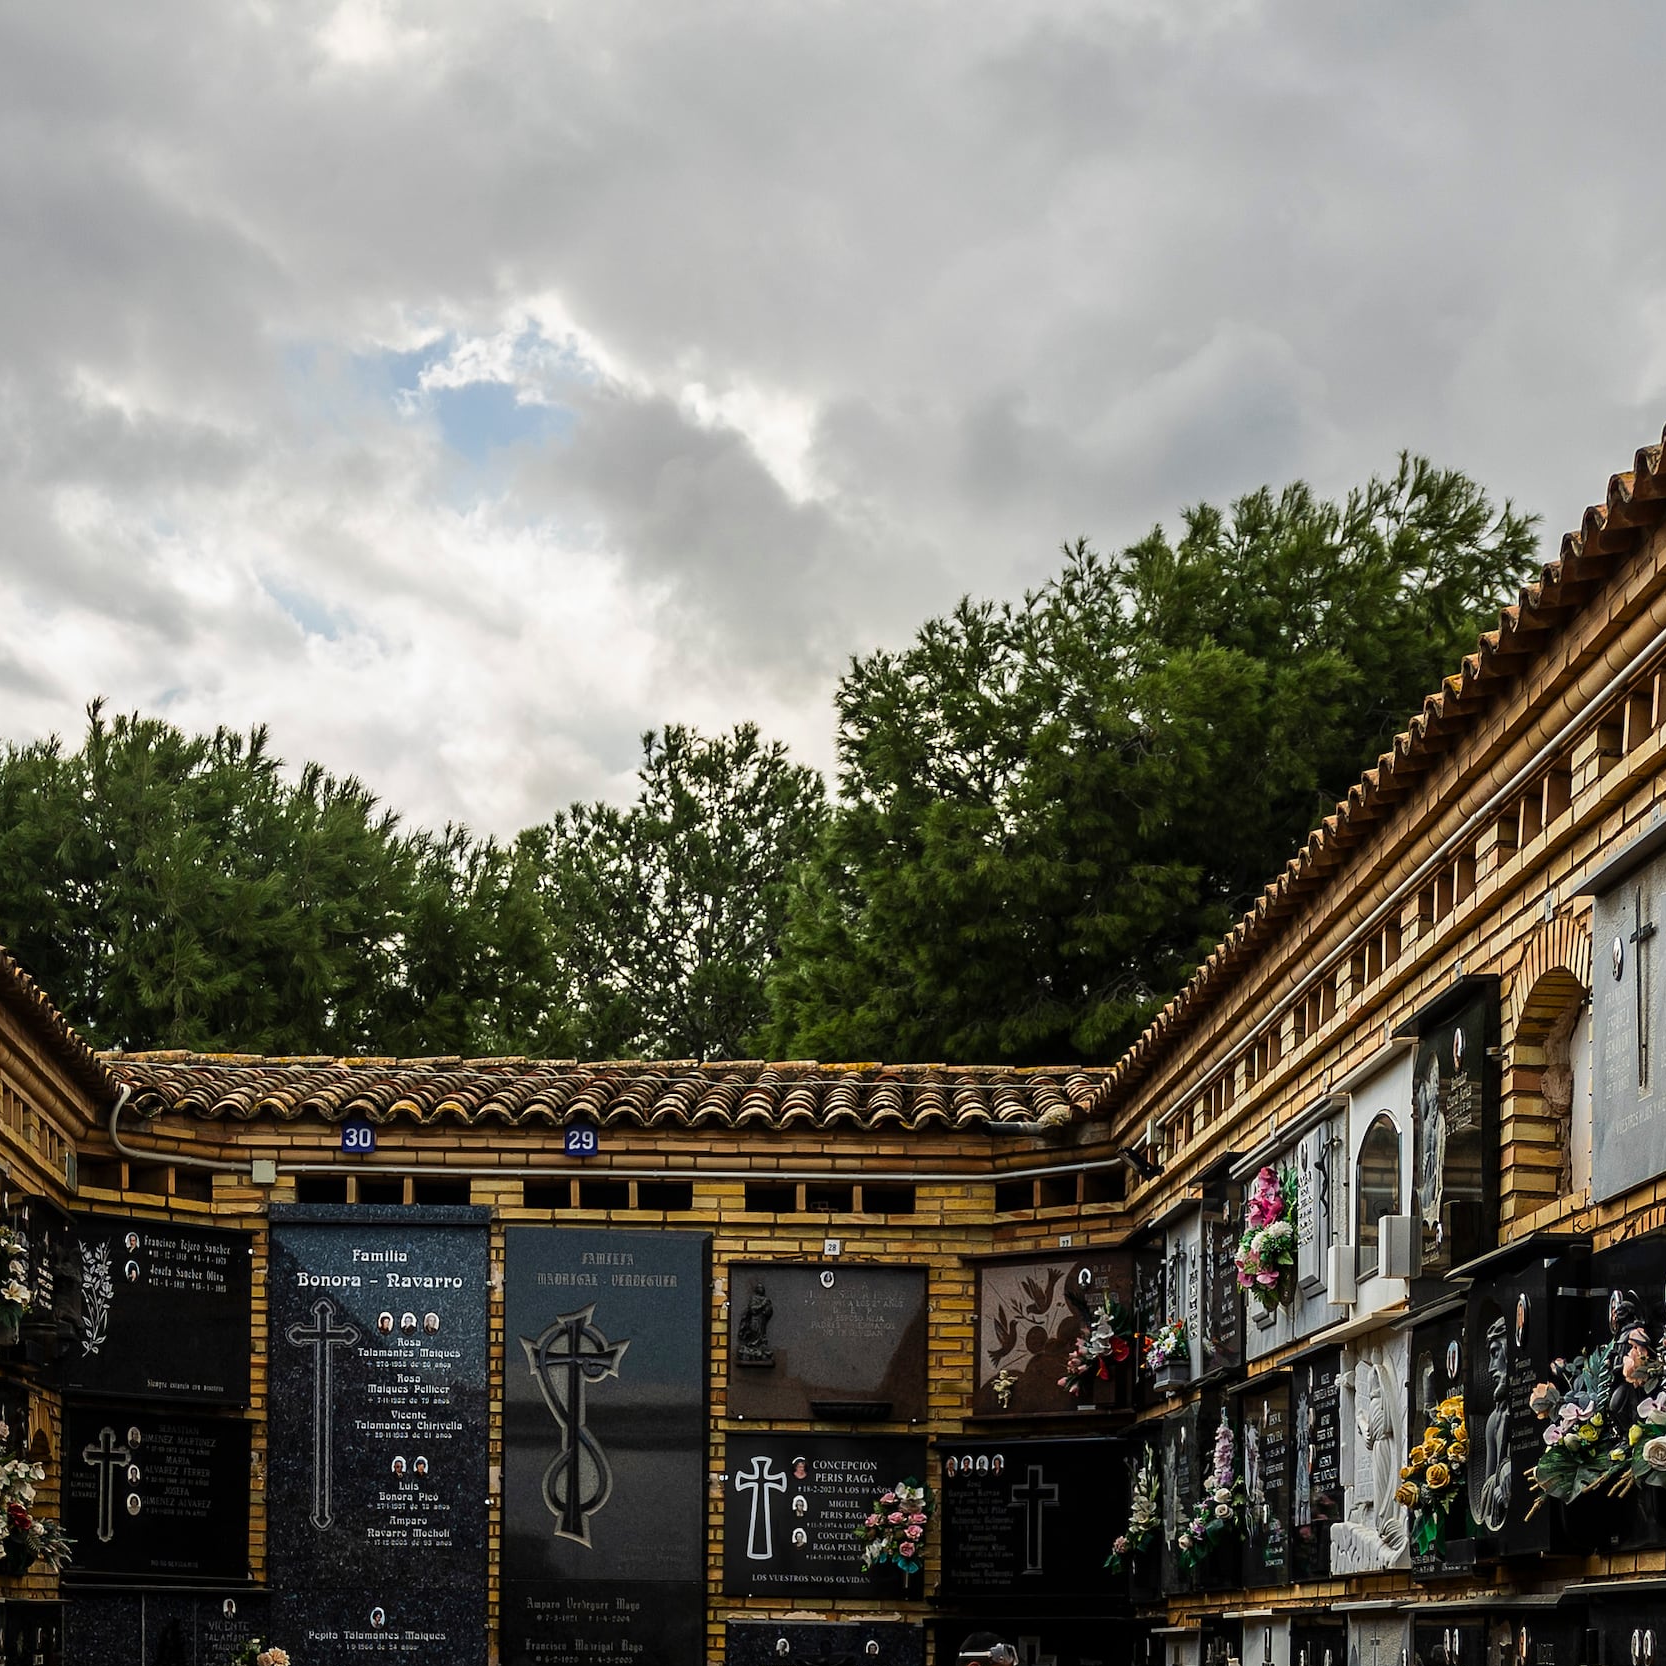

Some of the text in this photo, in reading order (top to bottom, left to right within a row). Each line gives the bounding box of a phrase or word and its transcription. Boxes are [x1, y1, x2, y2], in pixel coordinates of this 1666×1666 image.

[345, 1128, 372, 1148] 30
[568, 1131, 594, 1150] 29
[144, 1235, 177, 1249] Francisco
[352, 1249, 408, 1263] Familia
[582, 1252, 634, 1265] FAMILIA
[150, 1263, 172, 1277] Josefa
[297, 1272, 463, 1289] Bonora Navarro
[537, 1272, 677, 1288] MADRIGAL VERDEGUER
[397, 1338, 421, 1347] Rosa
[357, 1347, 461, 1359] Talamantes Maiques
[396, 1374, 421, 1383] Rosa
[367, 1384, 451, 1395] Maiques Pellicer
[391, 1410, 427, 1420] Vicente
[354, 1420, 463, 1431] Talamantes Chirivella
[165, 1455, 191, 1466] MARIA
[812, 1459, 878, 1471] CONCEPCIÓN
[183, 1467, 211, 1478] FERRER
[815, 1473, 875, 1484] PERIS RAGA
[398, 1481, 420, 1491] Luis
[378, 1492, 413, 1501] Bonora
[828, 1500, 861, 1509] MIGUEL
[820, 1510, 868, 1520] PERIS RAGA
[389, 1516, 428, 1527] Amparo
[367, 1528, 408, 1538] Navarro
[752, 1573, 871, 1584] LOS VUESTROS NO OS OLVIDAN
[525, 1596, 641, 1612] Amparo Verdeguer Mayo
[343, 1631, 400, 1640] Talamantes
[404, 1631, 447, 1642] Maiques
[525, 1638, 567, 1652] Francisco
[574, 1639, 613, 1653] Madrigal
